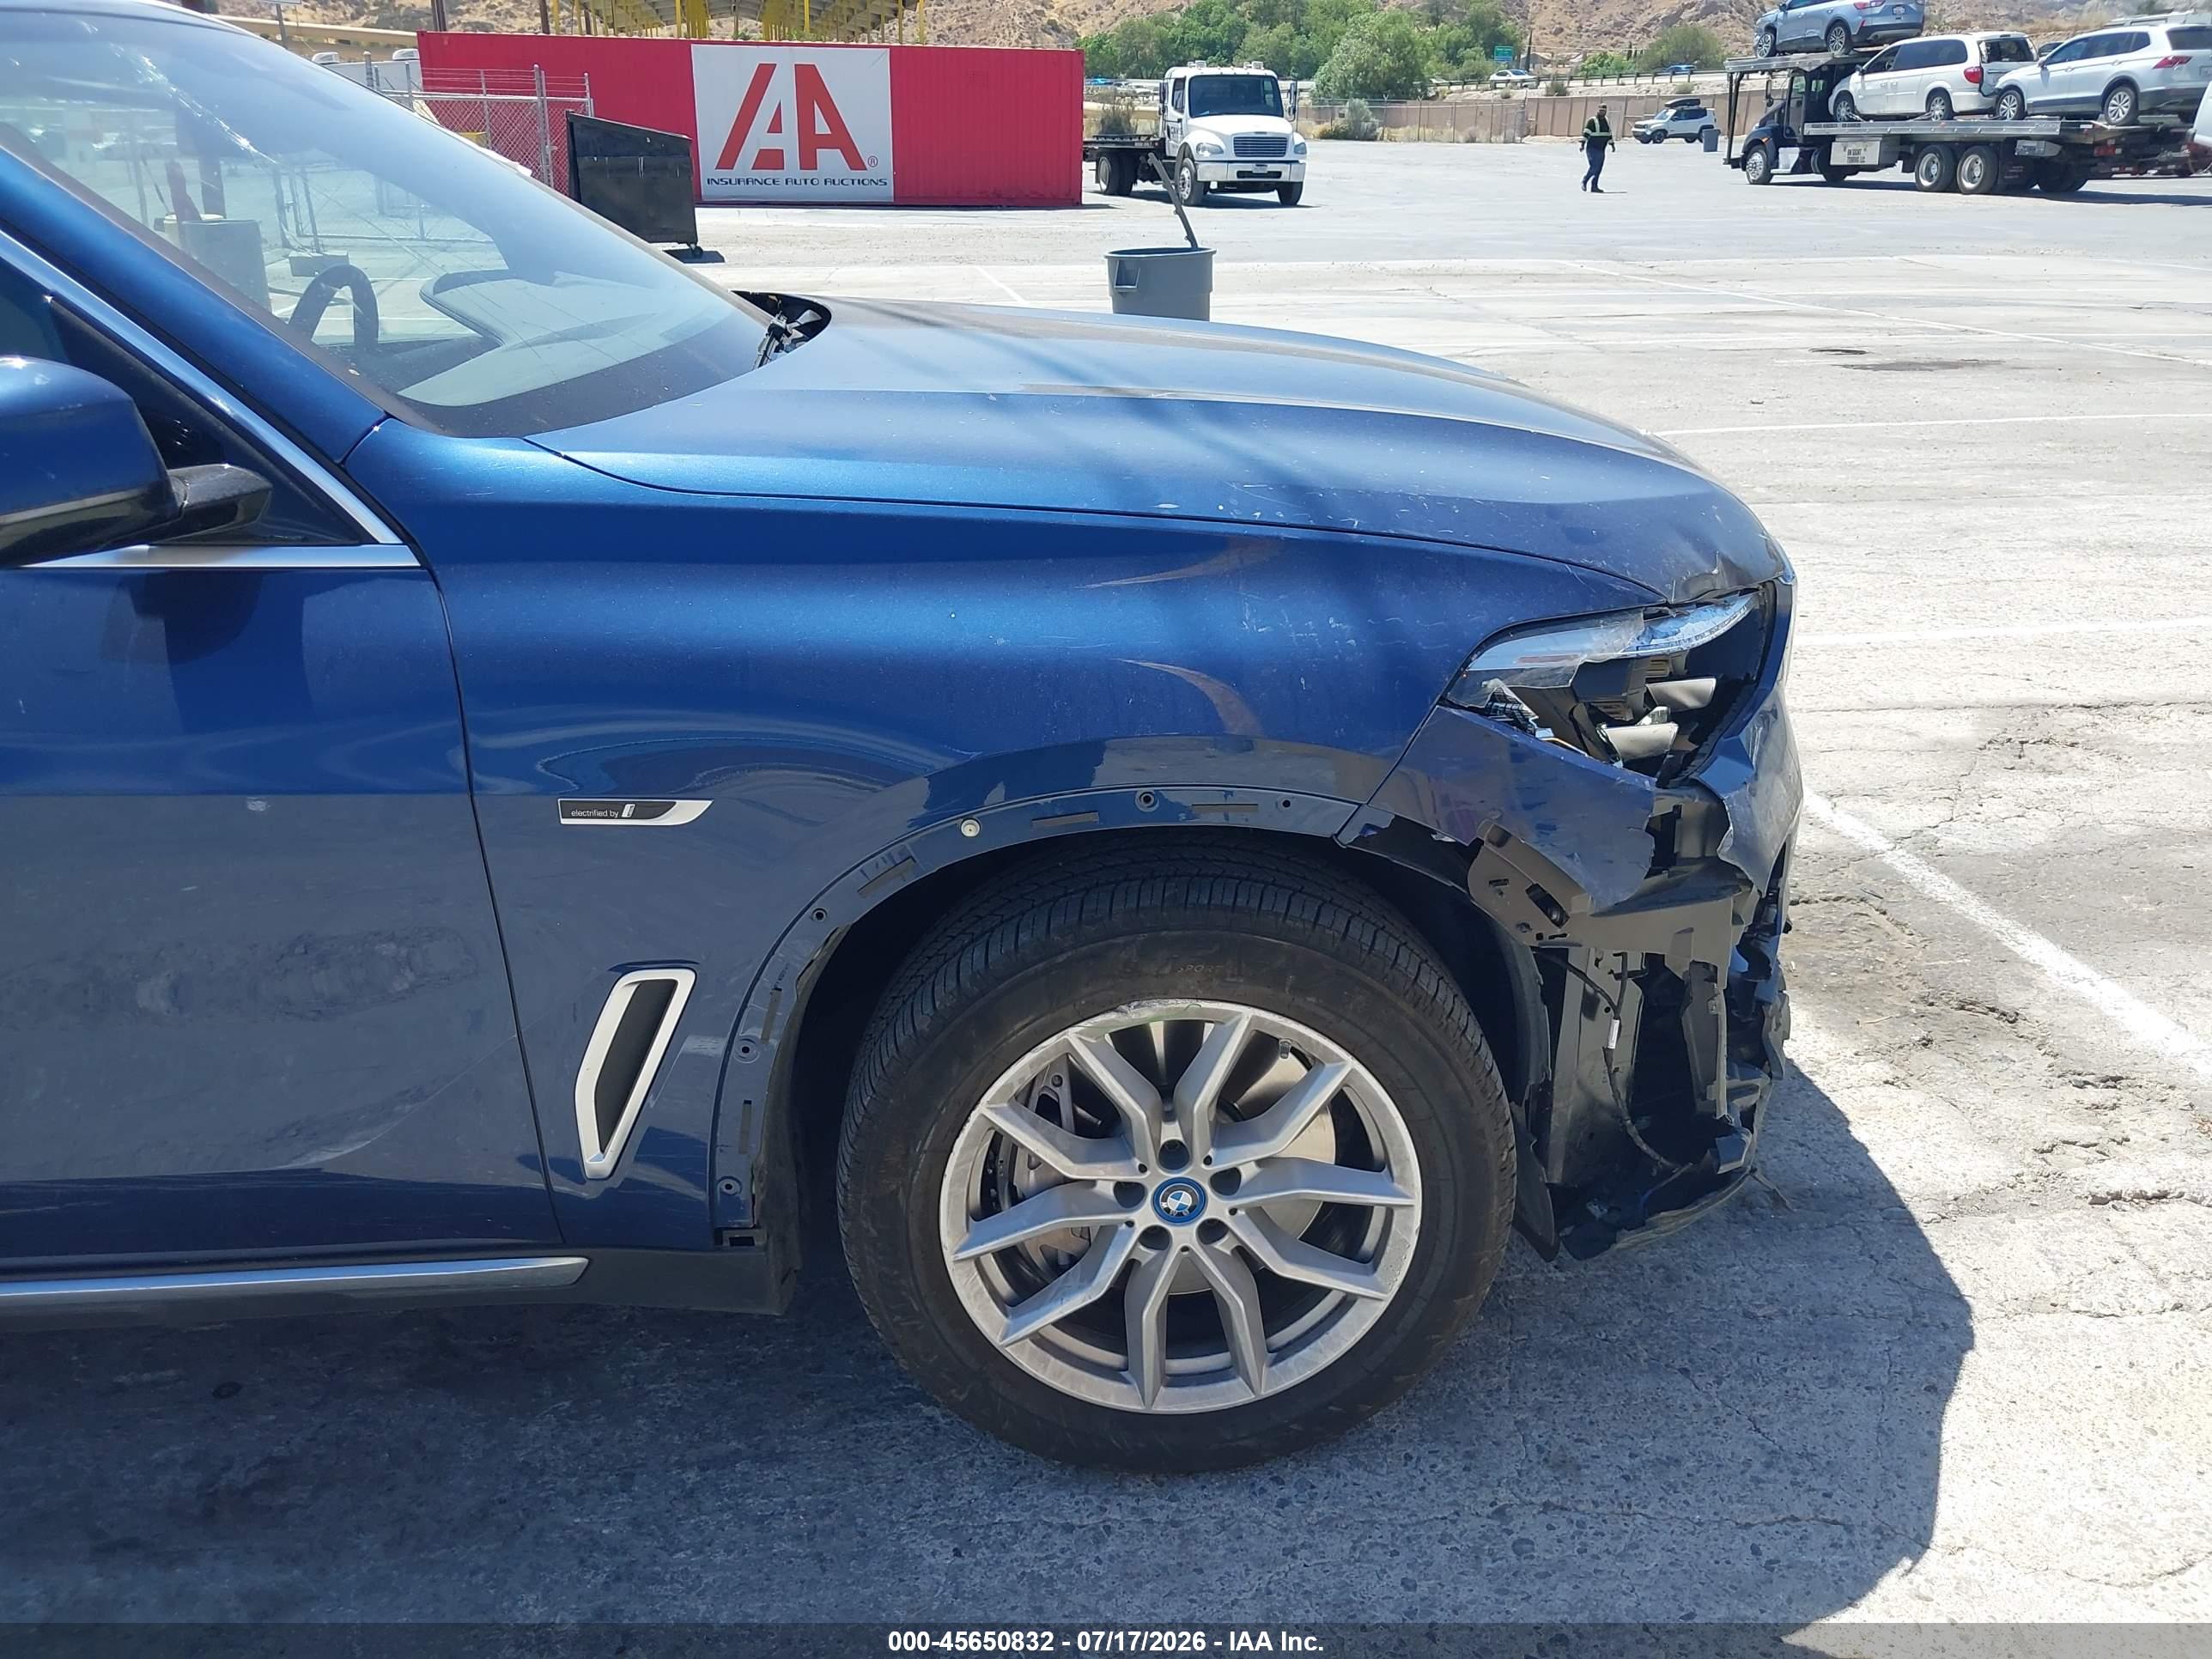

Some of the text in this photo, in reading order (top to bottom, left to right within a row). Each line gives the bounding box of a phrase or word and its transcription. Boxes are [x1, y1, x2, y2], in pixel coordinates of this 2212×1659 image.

[714, 63, 867, 171] IAA
[707, 177, 888, 186] INSURANCE AUTO AUCTIONS
[571, 807, 608, 817] electrified
[610, 808, 619, 818] by
